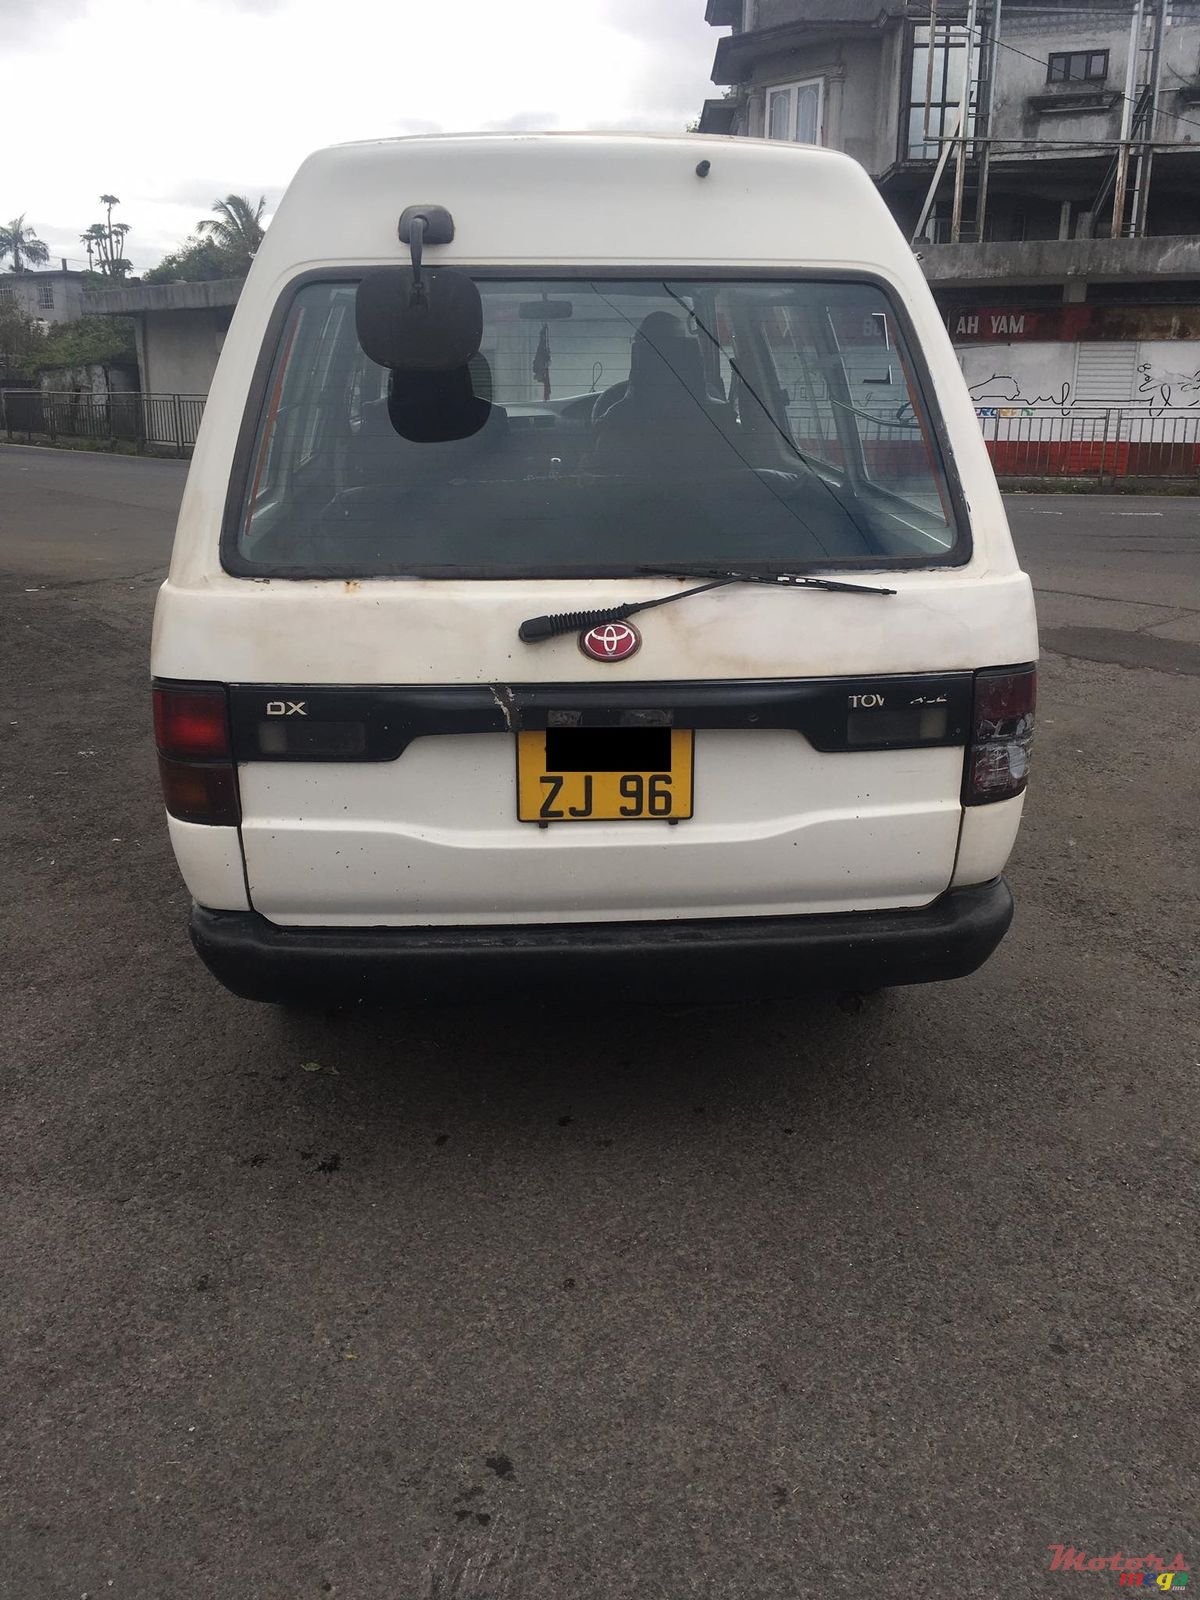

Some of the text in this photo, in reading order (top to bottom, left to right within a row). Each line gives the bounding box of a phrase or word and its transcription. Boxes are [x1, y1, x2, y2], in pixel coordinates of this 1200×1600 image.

[956, 316, 979, 334] AH
[990, 315, 1025, 334] YAM
[266, 701, 308, 716] DX
[539, 774, 673, 818] ZJ 96
